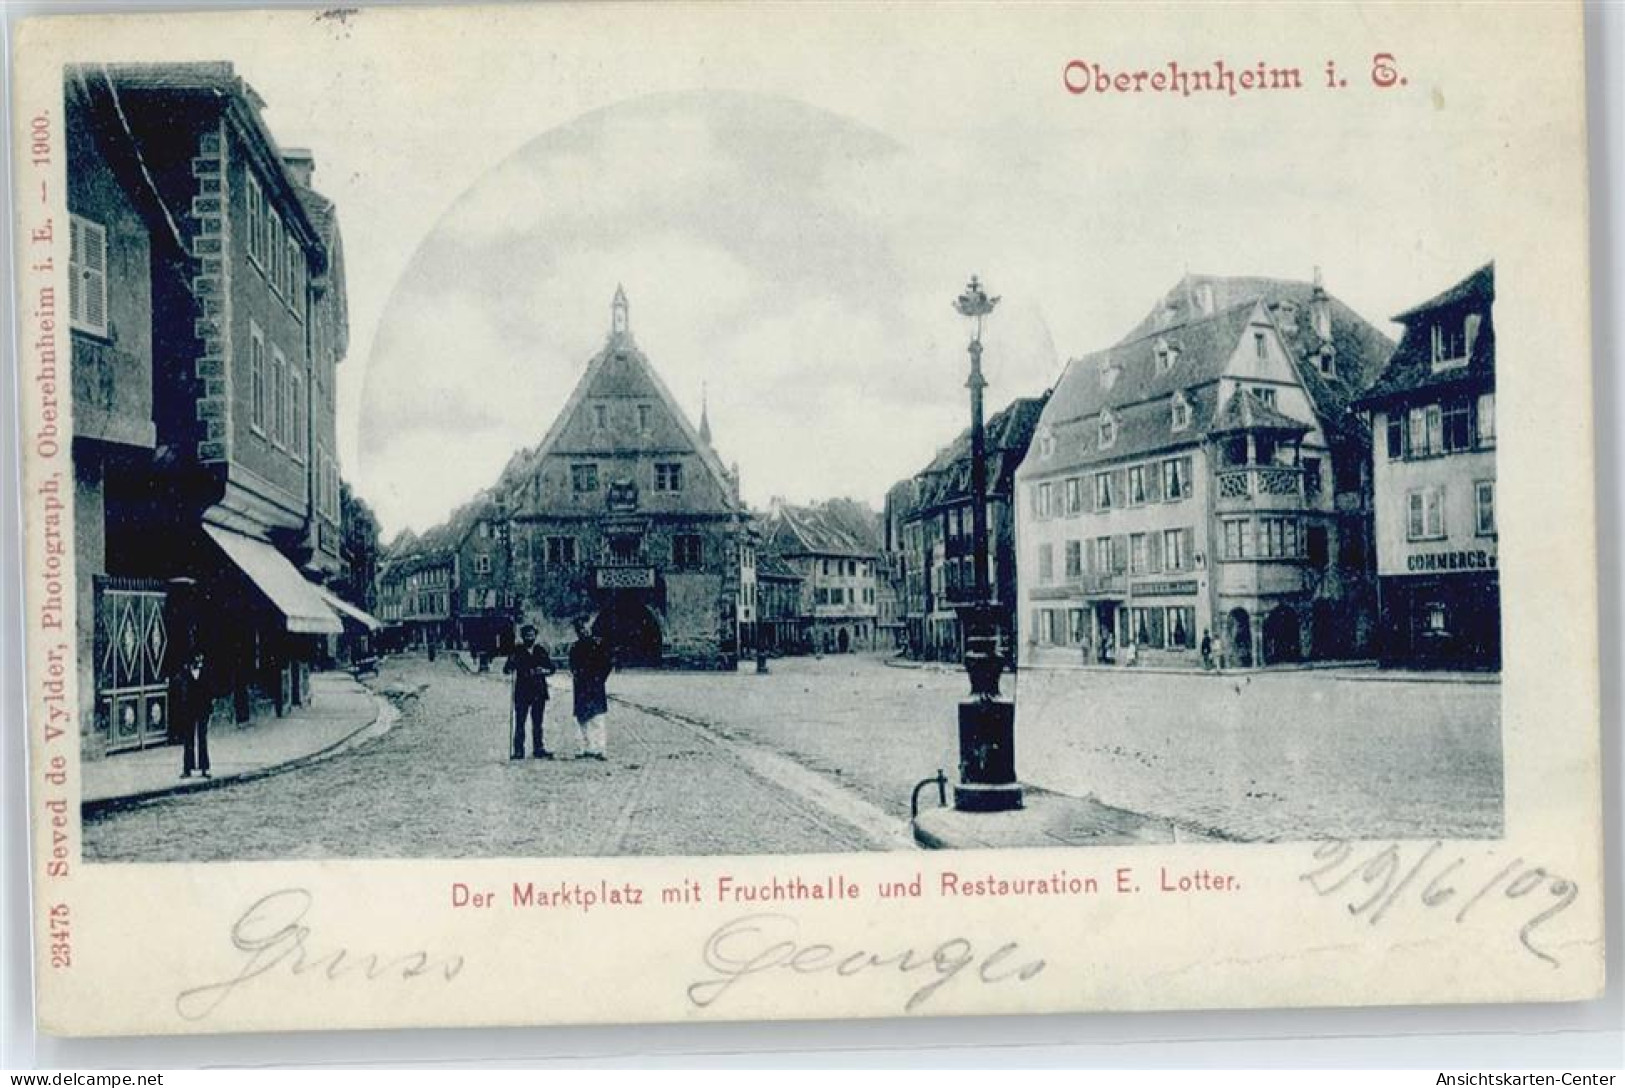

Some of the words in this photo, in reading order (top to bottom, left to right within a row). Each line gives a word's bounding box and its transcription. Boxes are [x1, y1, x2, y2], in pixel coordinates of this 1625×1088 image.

[1063, 58, 1303, 98] Oberehnheim
[1326, 60, 1347, 88] i.
[32, 110, 51, 164] 1900.
[34, 219, 53, 245] E.
[35, 256, 53, 273] i.
[35, 286, 58, 459] Oberehnheim
[40, 471, 65, 633] Photograph,
[42, 643, 70, 740] Vylder,
[45, 753, 67, 784] de
[43, 800, 69, 878] Seved
[451, 882, 495, 909] Der
[512, 880, 643, 912] Marktplatz
[661, 878, 702, 904] mit
[717, 875, 861, 903] Fruchthalle
[878, 872, 923, 898] und
[940, 870, 1098, 897] Restauration
[1116, 868, 1141, 894] E.
[1160, 866, 1242, 893] Lotter.
[47, 904, 72, 969] 23475
